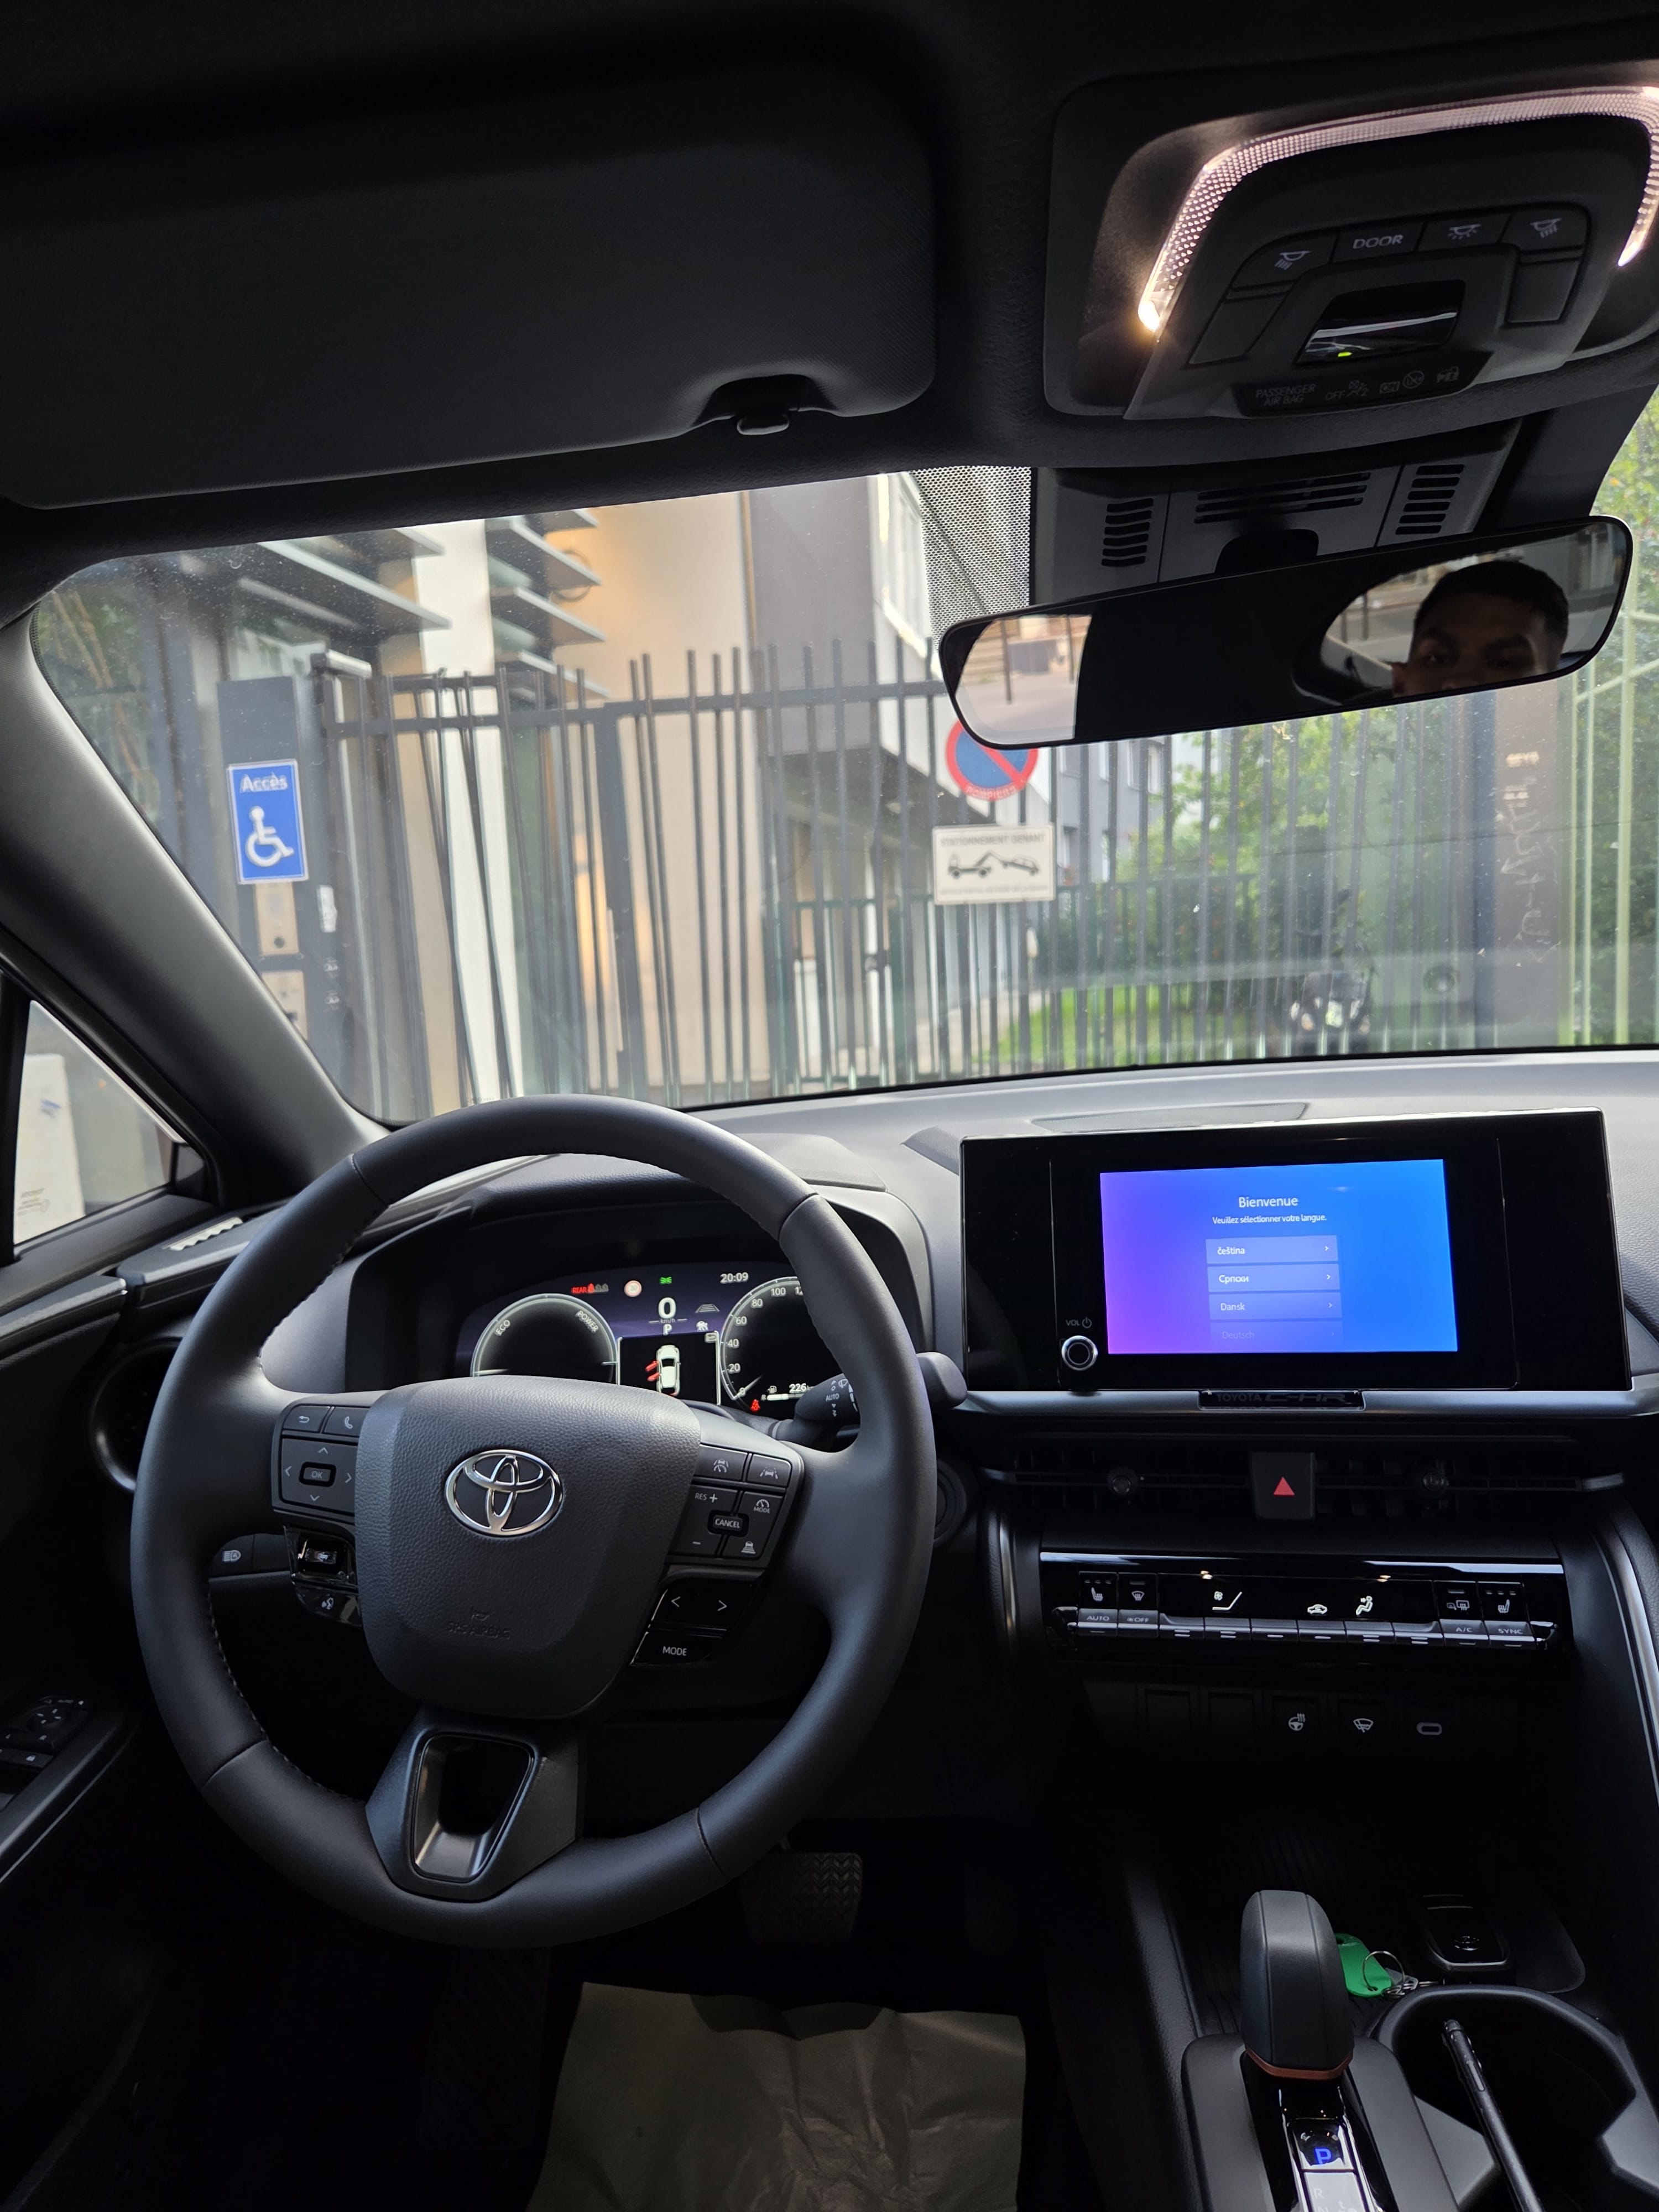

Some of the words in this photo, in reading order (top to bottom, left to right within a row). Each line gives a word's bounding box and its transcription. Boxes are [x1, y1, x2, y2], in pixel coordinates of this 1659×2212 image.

[1353, 234, 1404, 249] DOOR
[1255, 384, 1317, 398] PASSENGER
[1324, 390, 1345, 401] OFF
[1264, 395, 1281, 406] AIR
[1283, 393, 1304, 405] BAG
[239, 771, 288, 794] Accès
[1238, 1196, 1298, 1208] Bienvenue
[1212, 1216, 1239, 1224] Veuillez
[1240, 1215, 1281, 1224] sélectionner
[1282, 1214, 1300, 1222] votre
[1301, 1213, 1327, 1223] langue.
[1217, 1246, 1245, 1255] čeština
[720, 1272, 749, 1284] 20:09
[1218, 1275, 1249, 1285] Српски
[771, 1287, 786, 1297] 100
[658, 1297, 676, 1319] 0
[751, 1298, 763, 1308] 80
[1220, 1302, 1245, 1311] Dansk
[576, 1310, 599, 1333] POWER
[735, 1316, 747, 1326] 60
[494, 1319, 511, 1337] ECO
[663, 1324, 673, 1335] P
[1222, 1330, 1255, 1339] Deutsch
[727, 1338, 739, 1348] 40
[728, 1363, 741, 1373] 20
[789, 1383, 807, 1394] 226
[826, 1392, 840, 1401] AUTO
[1217, 1393, 1261, 1402] TOYOTA
[1265, 1393, 1346, 1402] C-HR
[311, 1470, 323, 1479] OK
[695, 1493, 707, 1501] RES
[714, 1518, 740, 1529] CANCEL
[662, 1646, 687, 1656] MODE
[1314, 2148, 1332, 2166] P
